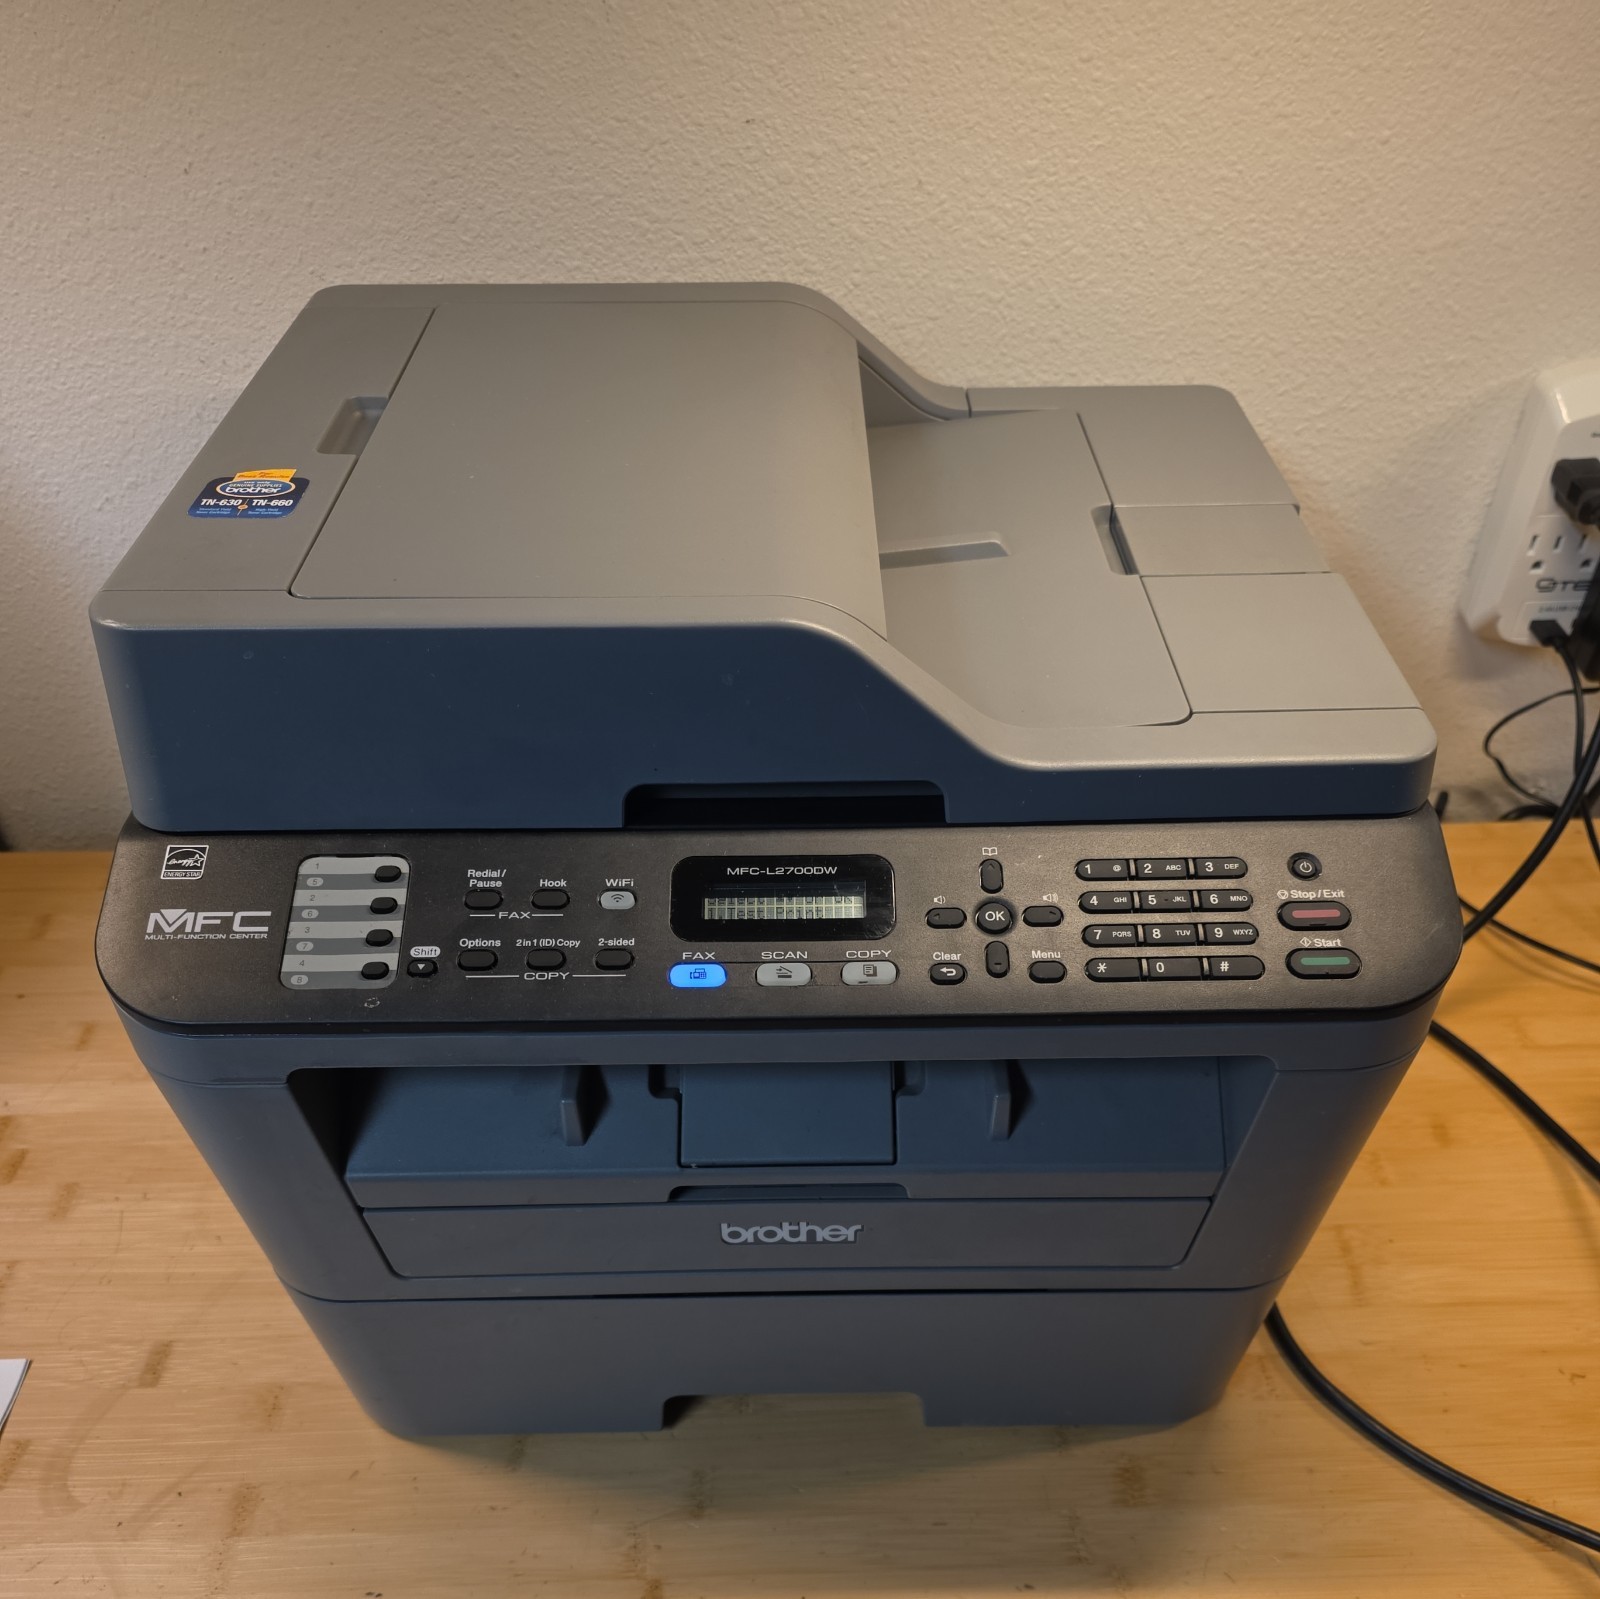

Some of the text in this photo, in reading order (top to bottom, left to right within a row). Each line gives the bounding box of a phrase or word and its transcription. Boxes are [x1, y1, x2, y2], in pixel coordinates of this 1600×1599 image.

[727, 866, 838, 875] MFC-L2700DW
[1084, 864, 1091, 874] 1
[1143, 863, 1152, 874] 2
[1205, 862, 1214, 872] 3
[469, 879, 502, 887] Pause
[539, 878, 567, 887] Hook
[605, 878, 634, 887] WiFi
[1089, 895, 1098, 905] 4
[1148, 895, 1157, 905] 5
[1209, 894, 1219, 904] 6
[498, 911, 531, 919] FAX
[985, 911, 1005, 921] OK
[146, 909, 272, 933] MFC
[1093, 929, 1102, 940] 7
[1152, 928, 1161, 939] 8
[1214, 927, 1223, 938] 9
[459, 938, 501, 948] Options
[539, 938, 555, 947] (ID)
[557, 938, 581, 948] Copy
[598, 938, 635, 946] 2-sided
[1314, 938, 1342, 948] Start
[413, 947, 438, 956] Shift
[682, 951, 716, 959] FAX
[761, 951, 808, 959] SCAN
[846, 950, 892, 959] COPY
[932, 952, 961, 960] Clear
[1031, 950, 1061, 959] Menu
[1156, 962, 1165, 973] 0
[1219, 961, 1230, 972] #
[524, 972, 570, 980] COPY
[720, 1221, 863, 1244] brother
